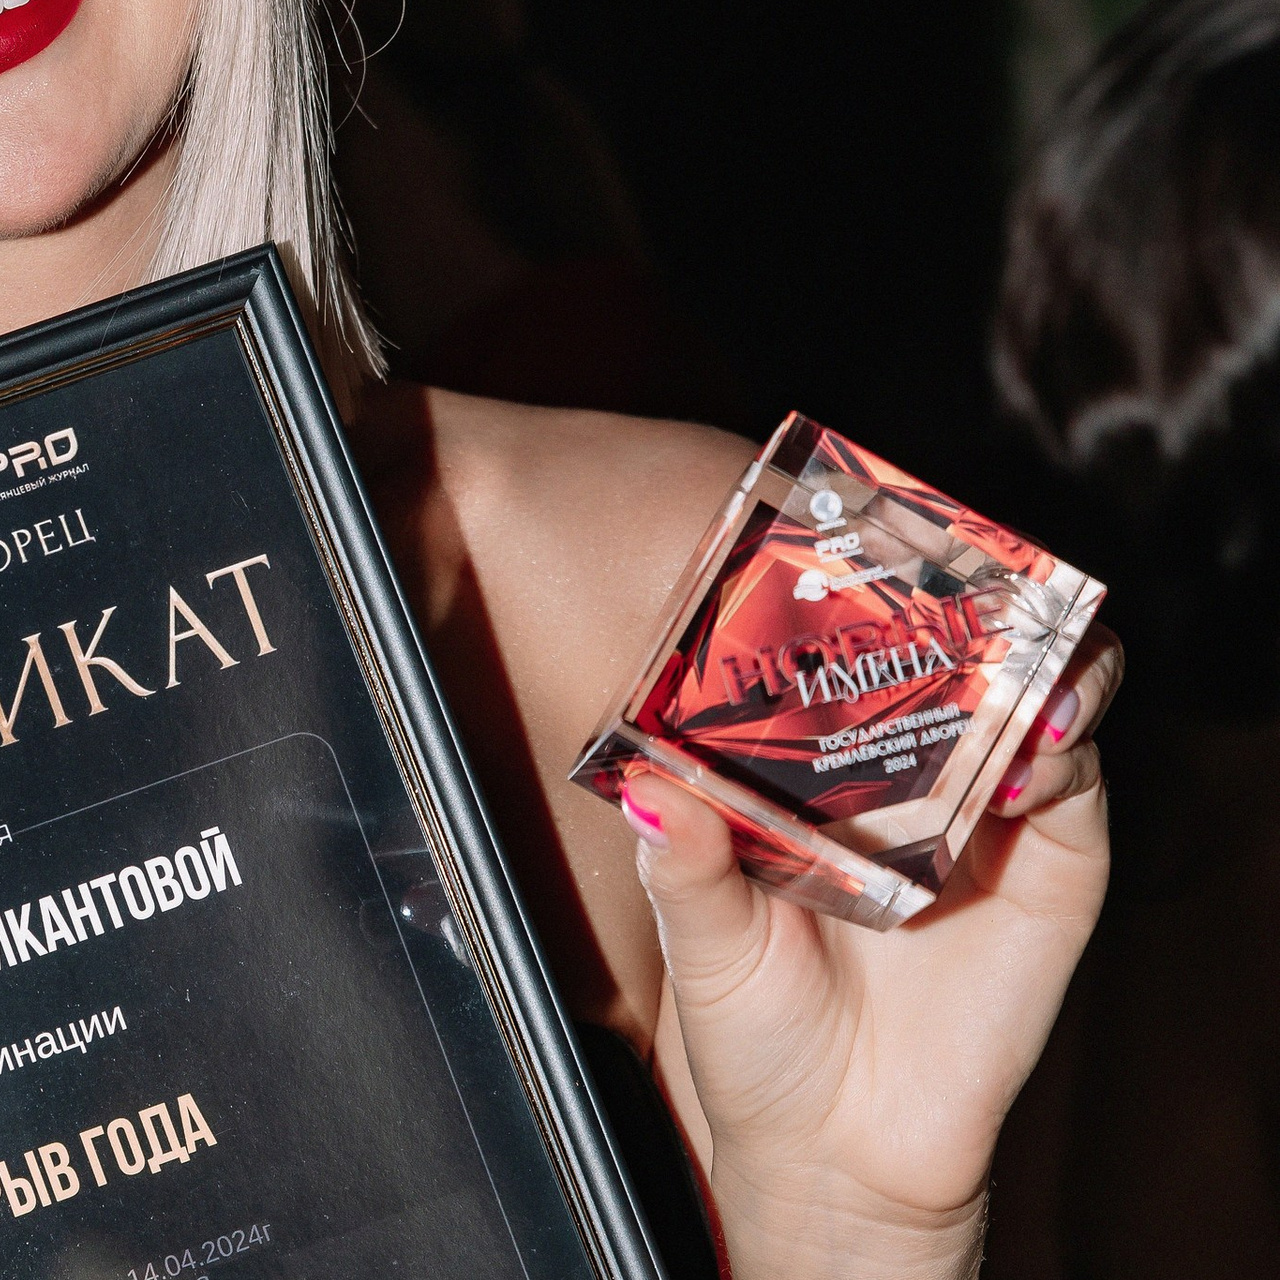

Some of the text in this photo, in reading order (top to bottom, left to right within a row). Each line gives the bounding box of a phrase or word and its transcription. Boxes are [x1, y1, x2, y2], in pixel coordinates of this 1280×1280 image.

[48, 463, 90, 484] ЖУРНАЛ
[720, 585, 1014, 707] НОВЫЕ
[794, 636, 958, 709] ИМЕНА
[818, 701, 961, 753] ГОСУДАРСТВЕННЫЙ
[883, 752, 918, 774] 2024
[80, 1092, 218, 1188] ГОДА
